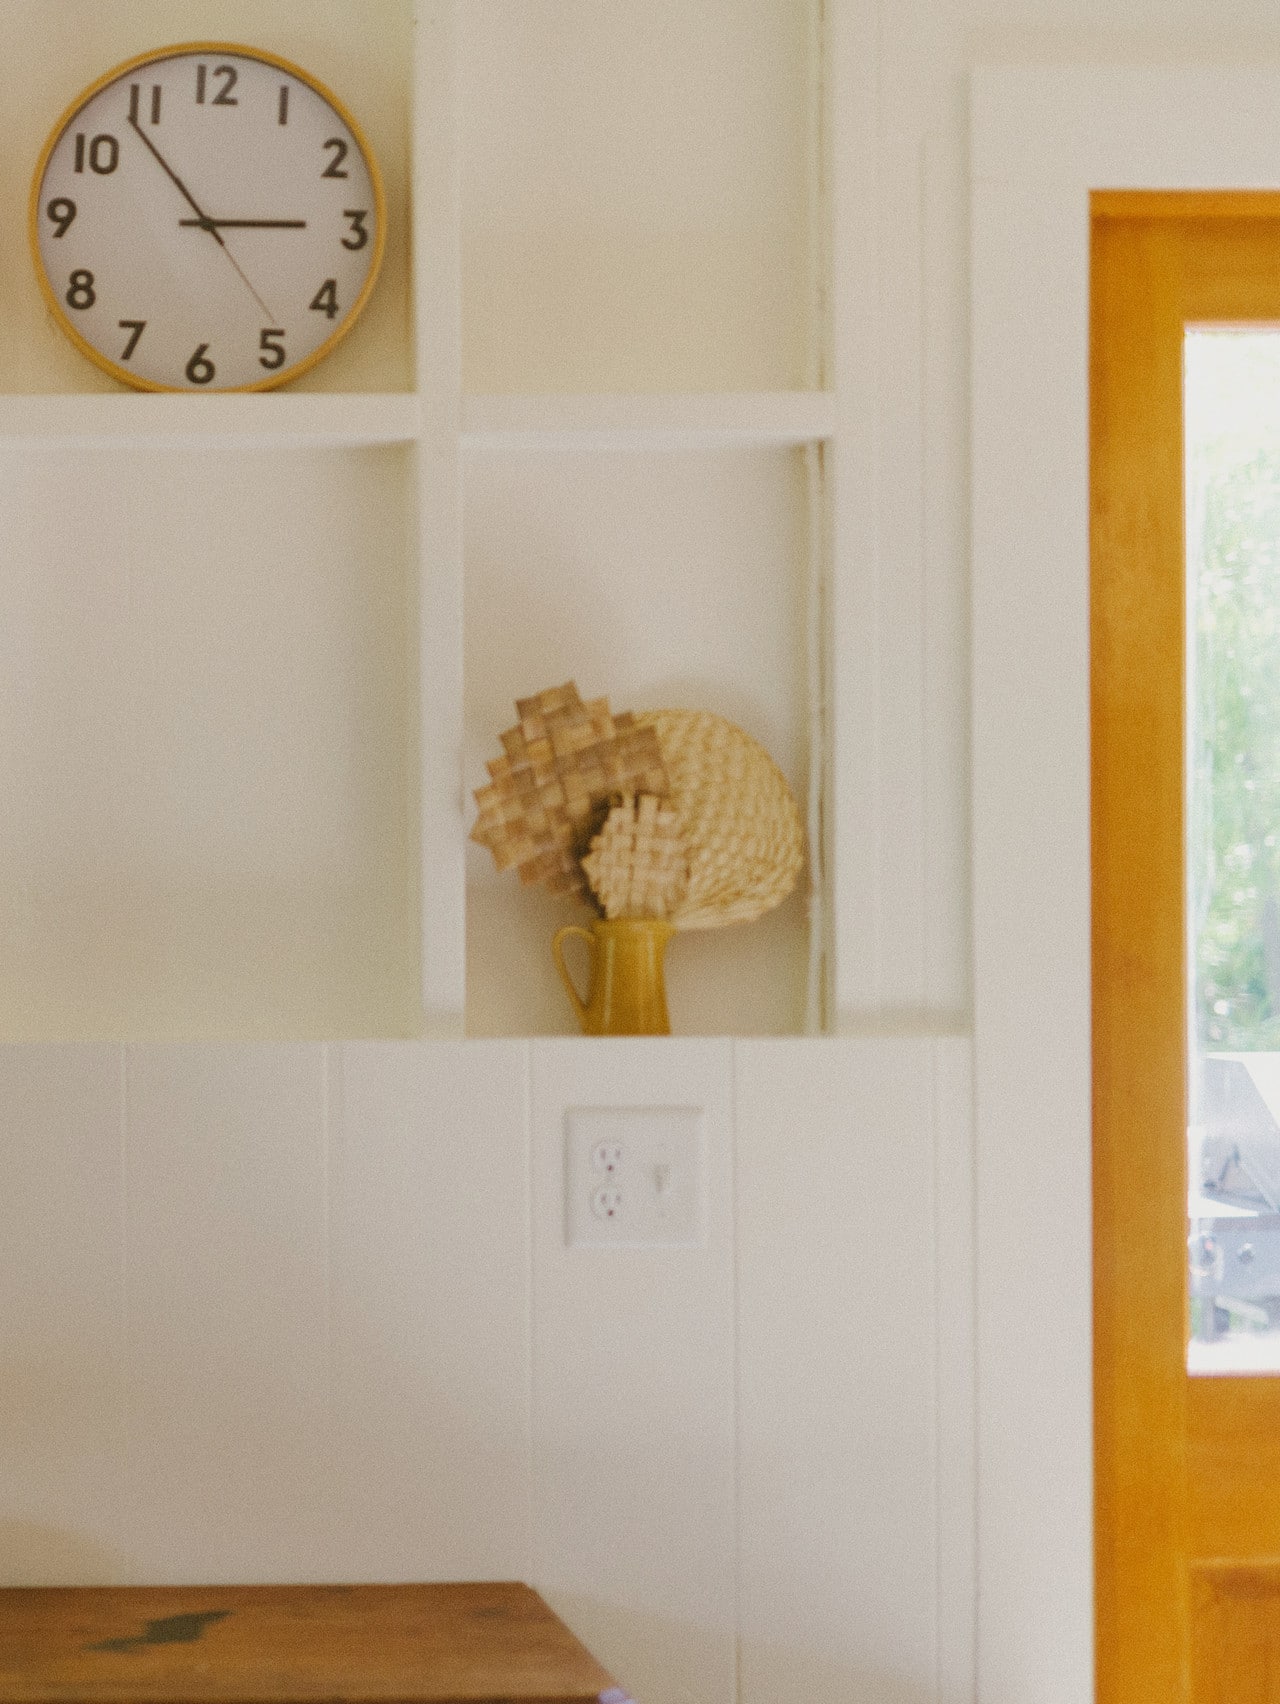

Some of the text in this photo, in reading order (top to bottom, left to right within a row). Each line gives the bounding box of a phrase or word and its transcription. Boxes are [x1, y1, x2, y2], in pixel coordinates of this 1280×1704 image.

[129, 84, 162, 126] 11
[196, 64, 238, 106] 12
[278, 85, 289, 126] 1
[74, 133, 120, 175] 10
[321, 138, 348, 179] 2
[47, 197, 78, 239] 9
[340, 209, 368, 251] 3
[66, 269, 97, 310] 8
[309, 279, 339, 319] 4
[119, 320, 147, 361] 7
[259, 328, 286, 370] 5
[185, 343, 216, 385] 6
